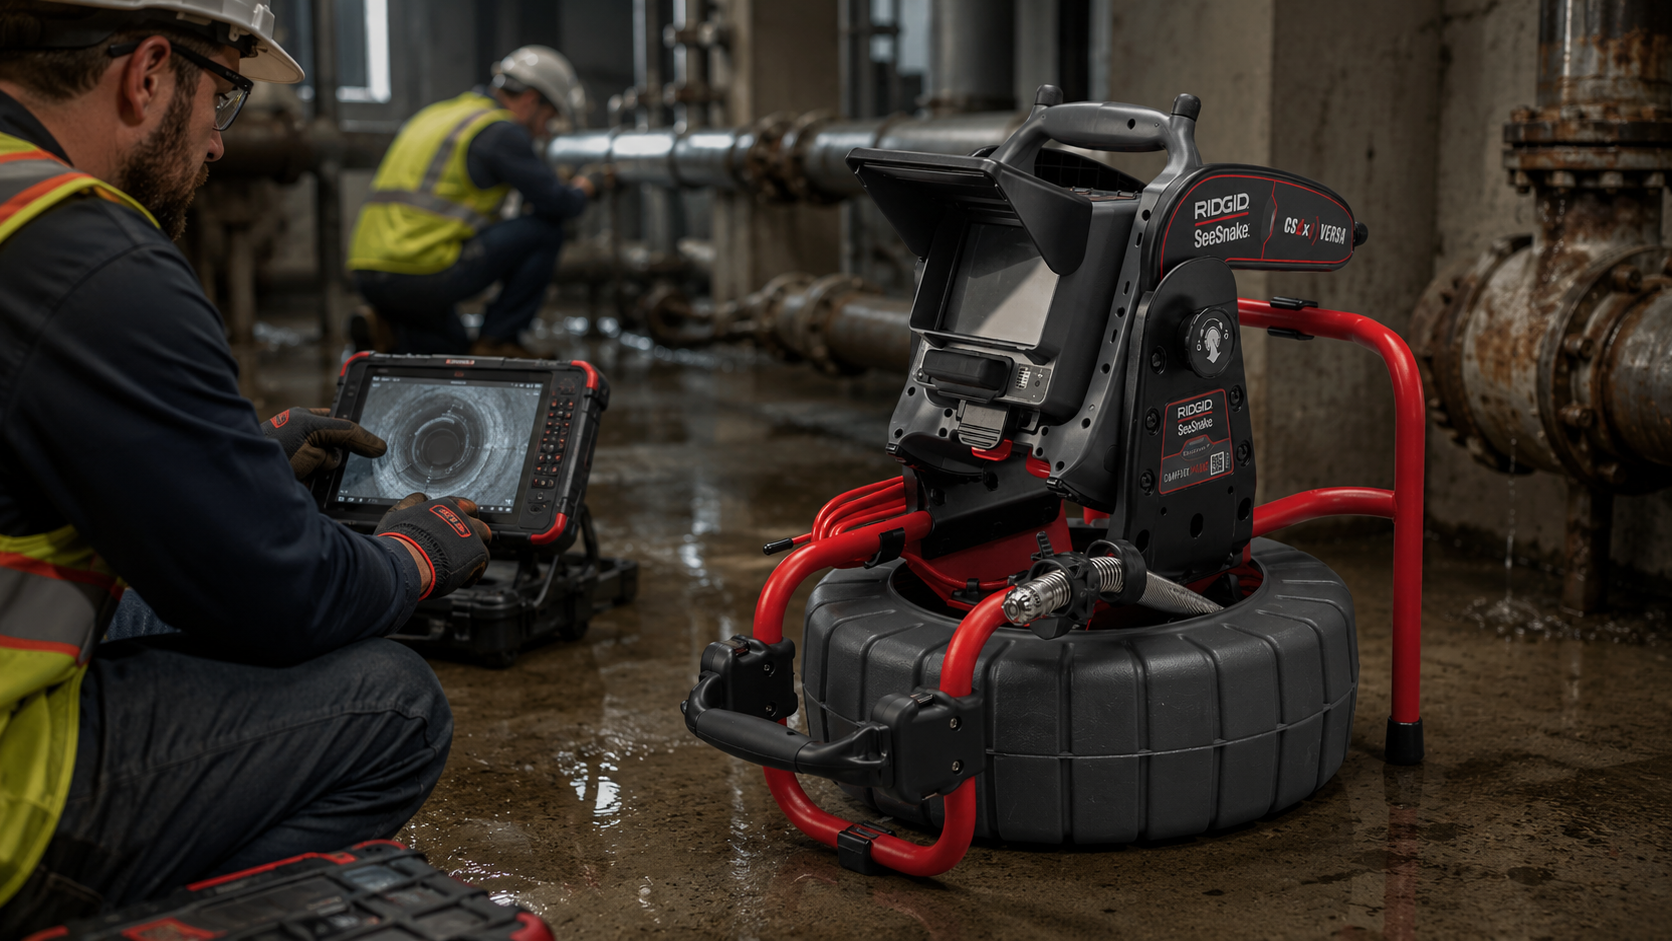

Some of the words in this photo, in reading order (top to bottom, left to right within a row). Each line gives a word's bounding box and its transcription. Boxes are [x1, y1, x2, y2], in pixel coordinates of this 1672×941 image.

[1194, 193, 1249, 219] RIDGID
[1194, 222, 1250, 248] SeeSnake
[1320, 223, 1346, 245] VERSA
[1177, 399, 1213, 418] RIDGID
